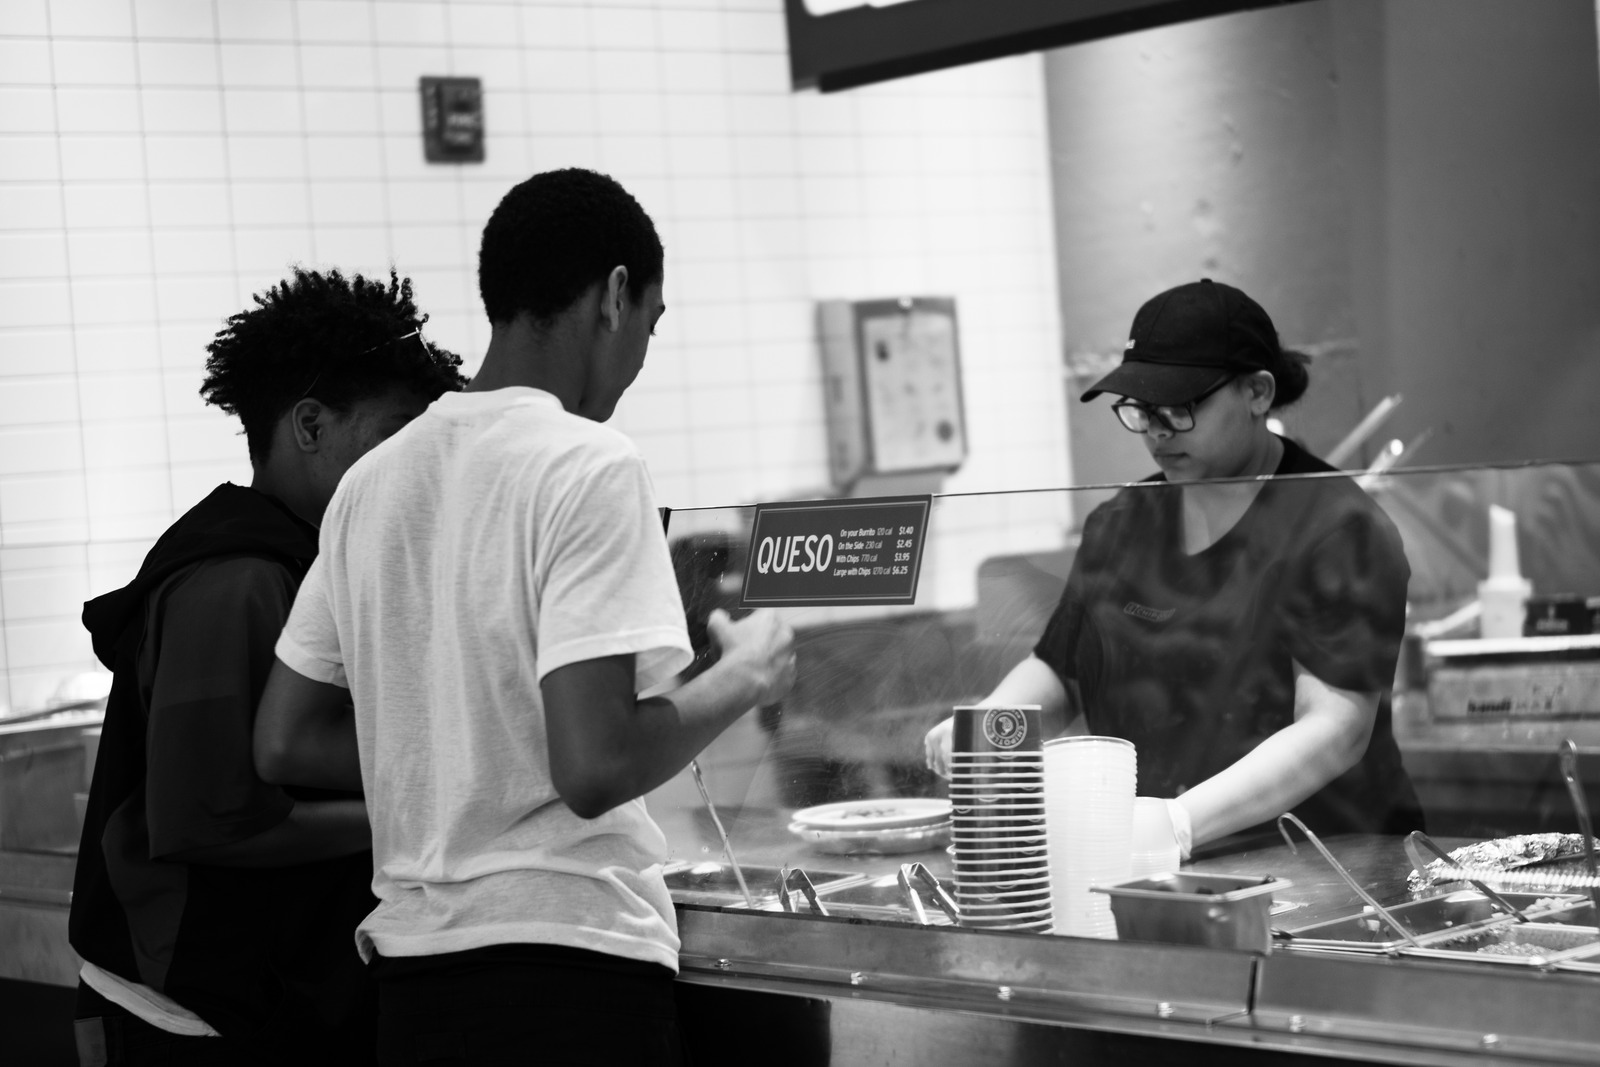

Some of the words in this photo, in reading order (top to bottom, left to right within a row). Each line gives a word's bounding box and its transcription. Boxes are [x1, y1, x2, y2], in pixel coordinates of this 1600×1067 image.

[840, 529, 847, 537] On
[847, 530, 858, 538] your
[859, 527, 875, 536] Burrito
[885, 527, 893, 536] cal
[899, 526, 914, 535] $1.40
[838, 542, 845, 550] On
[845, 542, 853, 550] the
[854, 541, 864, 550] Side
[865, 541, 875, 549] 230
[875, 540, 883, 549] cal
[896, 539, 913, 549] $2.45
[757, 534, 833, 574] QUESO
[846, 554, 860, 564] Chips
[861, 553, 870, 562] 770
[870, 553, 878, 562] cal
[894, 552, 910, 562] $3.95
[833, 568, 847, 578] Large
[847, 567, 858, 576] with
[858, 566, 871, 577] Chips
[883, 566, 891, 575] cal
[892, 565, 908, 575] $6.25
